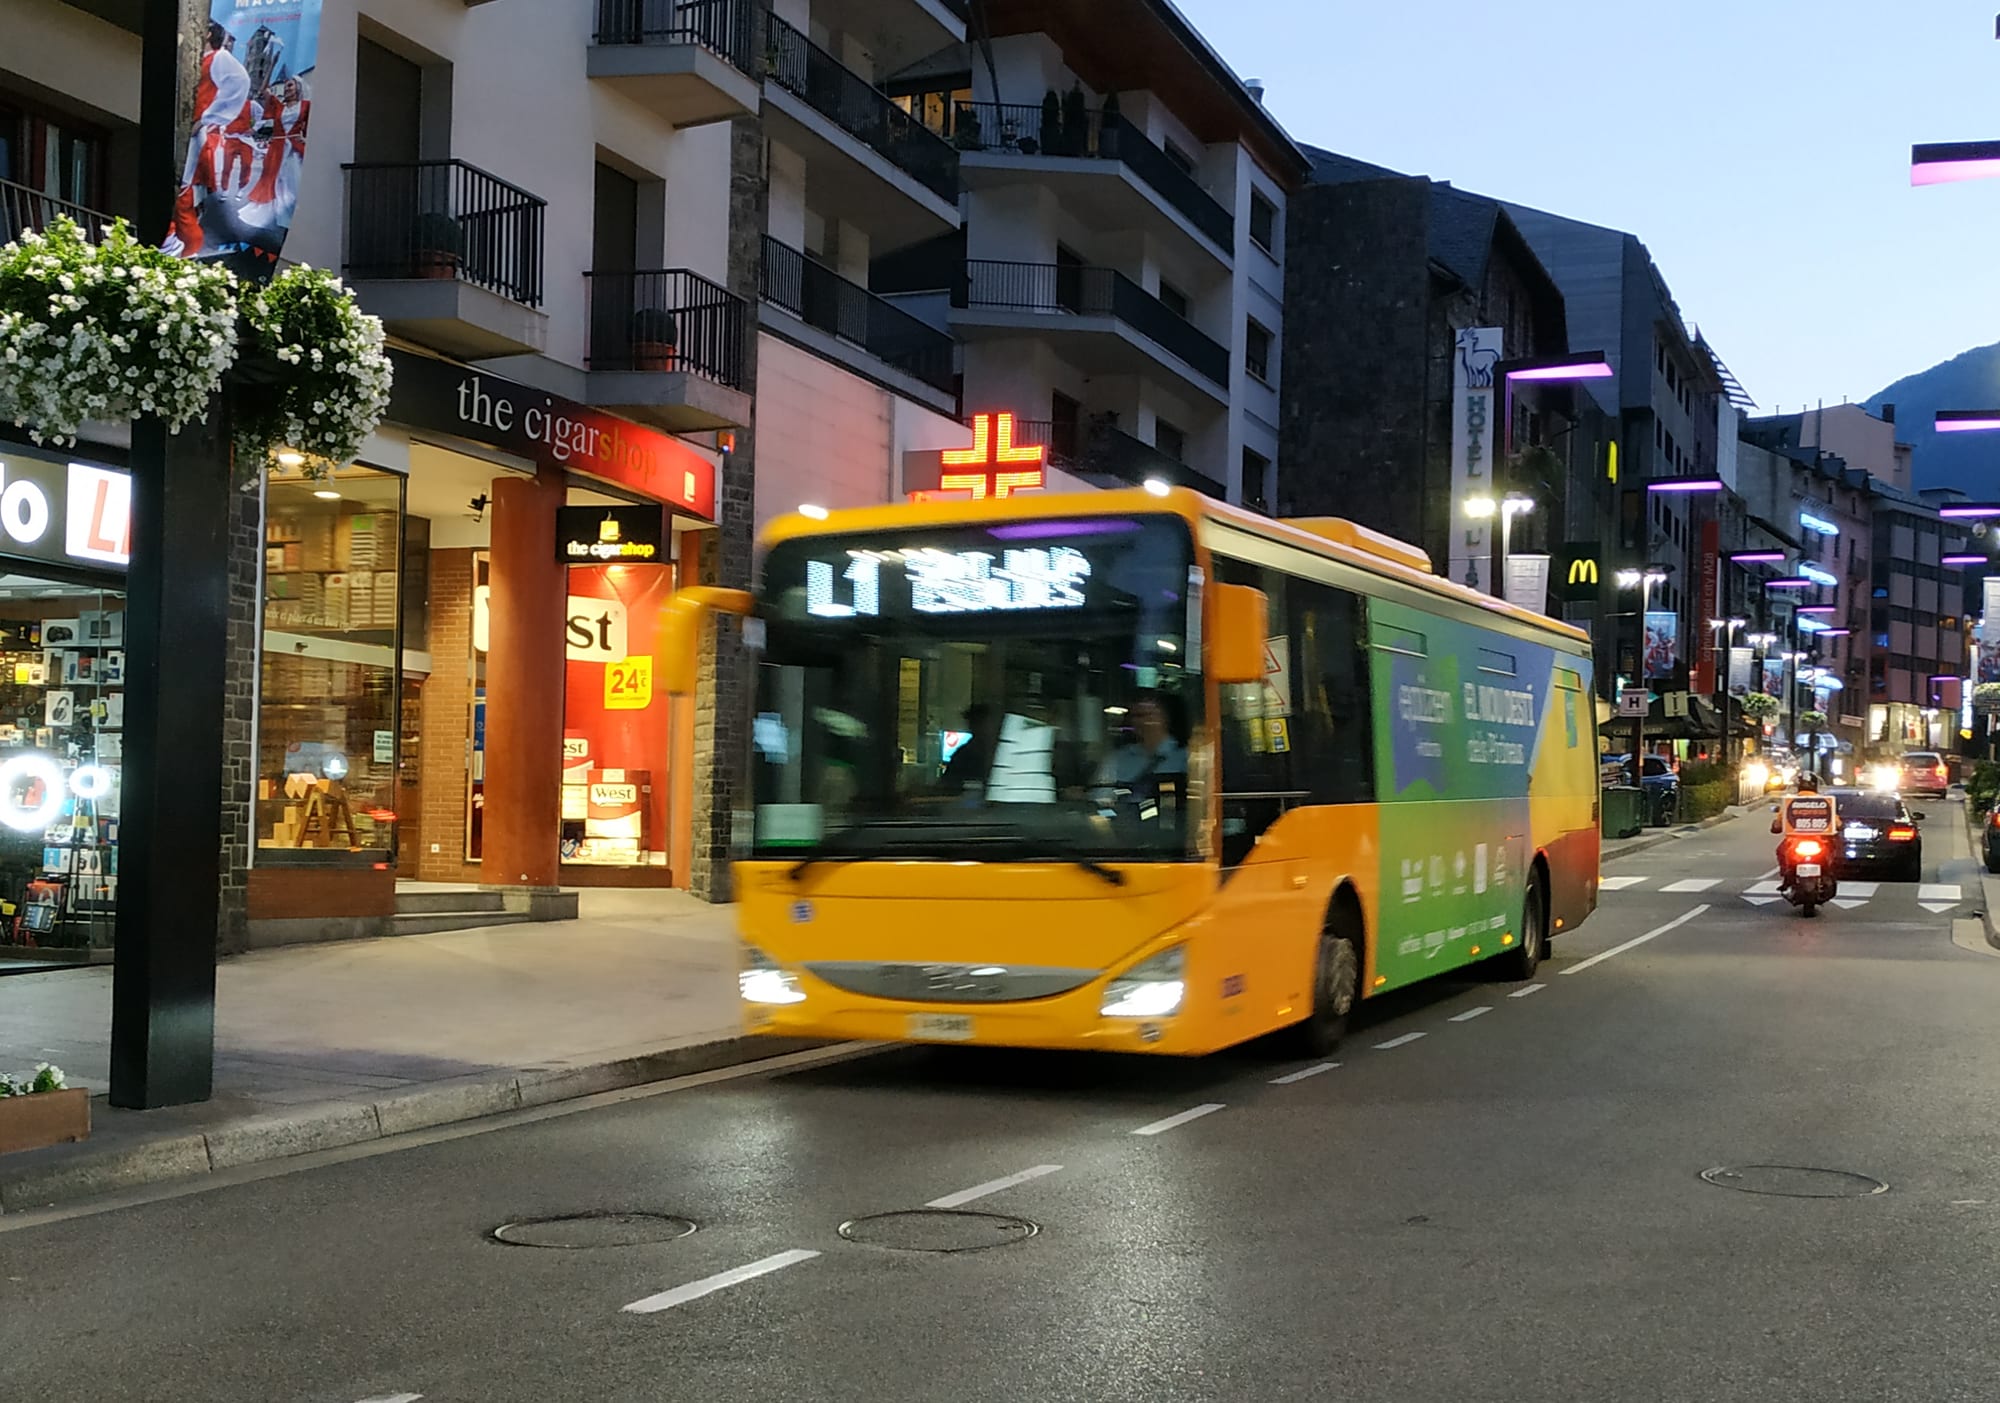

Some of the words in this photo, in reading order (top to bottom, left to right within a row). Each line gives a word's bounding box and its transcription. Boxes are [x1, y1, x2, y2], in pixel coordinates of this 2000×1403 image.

[457, 376, 514, 432] the
[524, 398, 658, 484] cigarshop
[1466, 396, 1486, 477] HOTEL
[87, 478, 131, 556] L
[567, 540, 589, 556] the
[590, 540, 656, 560] cigarshop
[807, 552, 881, 618] L1
[1629, 696, 1640, 708] H
[595, 787, 632, 800] West
